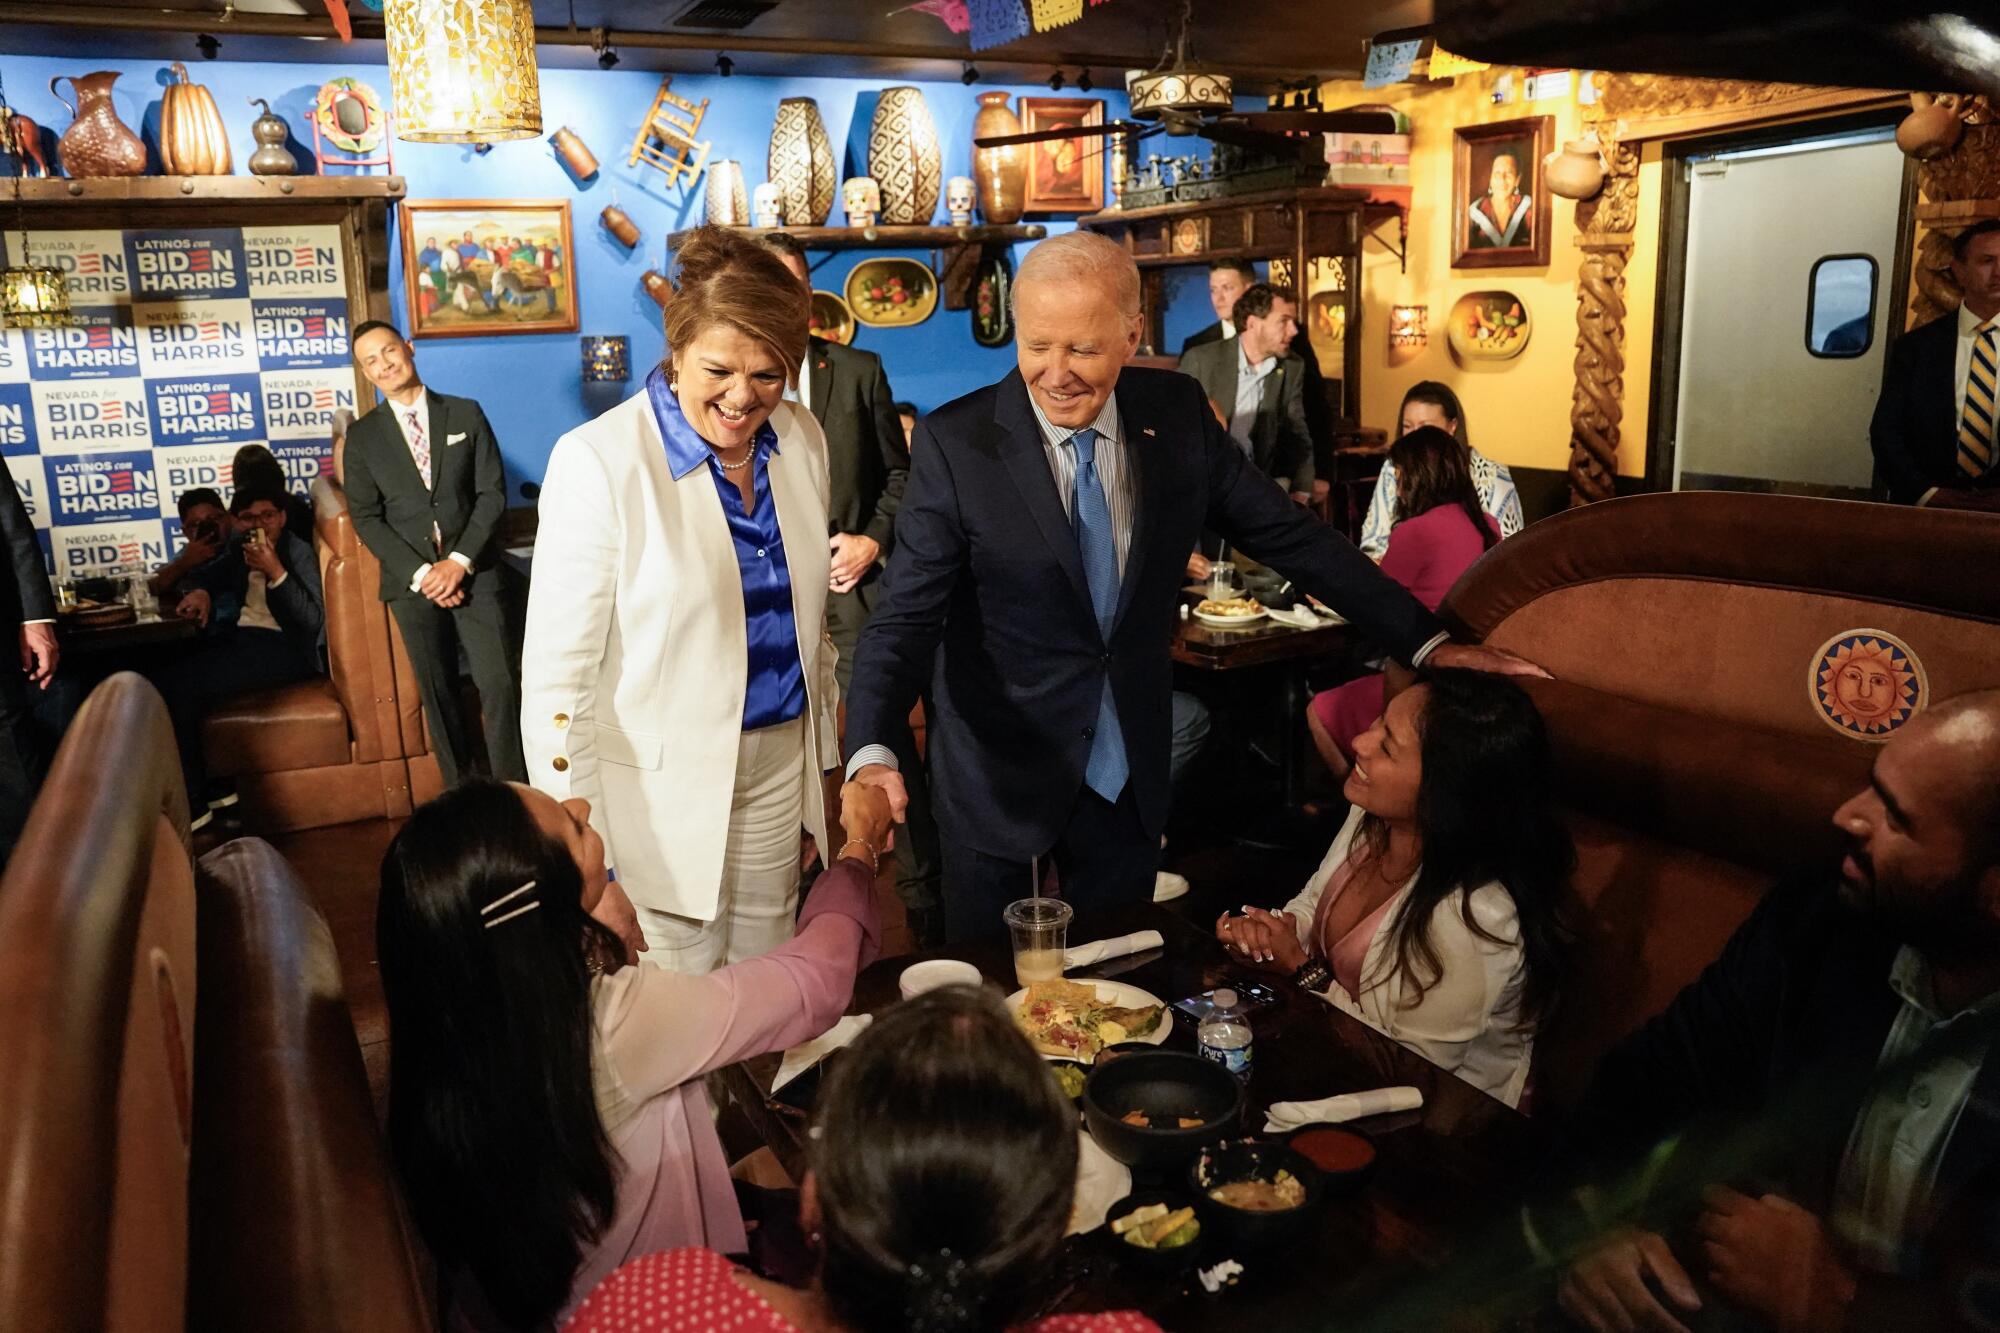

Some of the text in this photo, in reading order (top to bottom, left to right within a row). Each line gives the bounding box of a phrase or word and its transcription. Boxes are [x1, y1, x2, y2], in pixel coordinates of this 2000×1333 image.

[135, 239, 191, 250] LATINOS
[137, 249, 234, 273] BIDEN
[247, 247, 335, 268] BIDEN
[65, 277, 127, 292] RRIS
[141, 271, 237, 291] HARRIS
[250, 268, 337, 286] HARRIS
[145, 311, 197, 322] NEVADA
[254, 306, 307, 317] LATINOS
[33, 326, 135, 349] BIDEN
[150, 321, 242, 343] BIDEN
[255, 317, 346, 340] BIDEN
[152, 343, 244, 361] HARRIS
[257, 337, 348, 357] HARRIS
[36, 348, 138, 368] HARRIS
[156, 382, 211, 395] LATINOS
[265, 379, 313, 389] NEVADA
[45, 390, 99, 401] NEVADA
[157, 391, 252, 417] BIDEN
[267, 389, 353, 410] BIDEN
[48, 400, 145, 422] BIDEN
[269, 411, 333, 427] HARR
[51, 421, 148, 441] HARRIS
[160, 412, 255, 435] HARRIS
[55, 460, 113, 474] LATINOS
[166, 454, 216, 465] NEVADA
[277, 456, 337, 478] BIDE
[57, 470, 157, 496] BIDEN
[169, 465, 234, 486] BIDE
[59, 490, 159, 514] HARRIS
[65, 533, 117, 545] NEVADA
[67, 541, 162, 567] BIDEN
[1204, 1046, 1223, 1058] Pure
